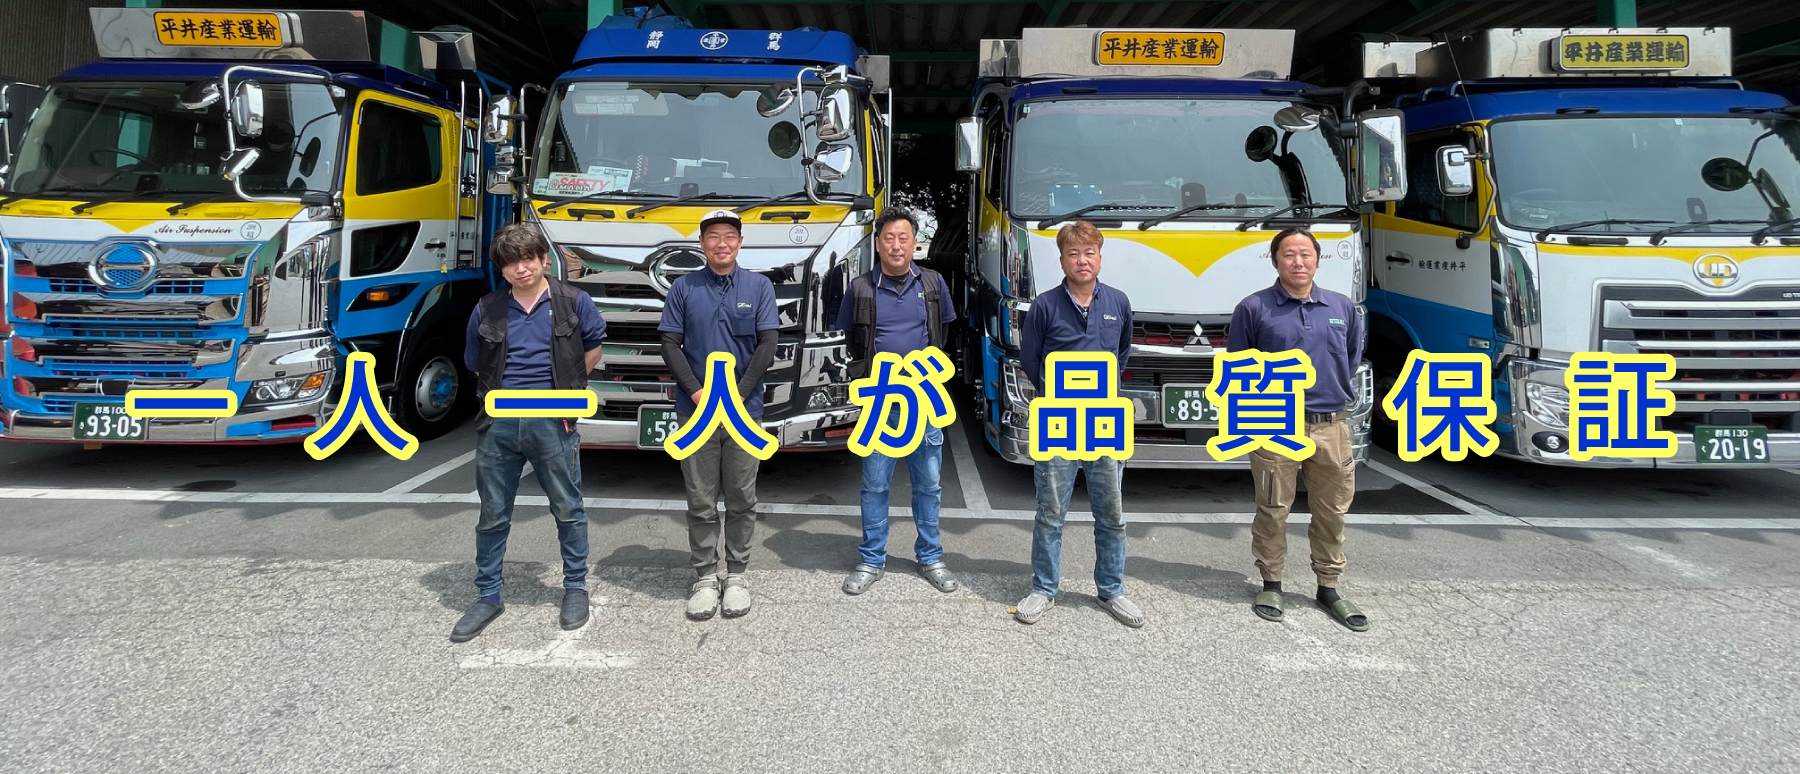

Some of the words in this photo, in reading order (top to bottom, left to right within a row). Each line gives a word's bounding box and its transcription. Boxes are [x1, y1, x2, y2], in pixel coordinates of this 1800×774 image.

[160, 18, 277, 40] 平井産業運輸
[1103, 37, 1220, 59] 平井産業運輸
[1564, 41, 1685, 63] 平井産業運輸
[560, 177, 611, 192] SAFETY
[154, 224, 174, 234] Air
[176, 224, 233, 237] Suspension
[1699, 262, 1737, 278] UD
[1178, 399, 1219, 421] 89-5
[86, 415, 143, 437] 93-05
[655, 421, 680, 443] 58
[1708, 438, 1766, 460] 20-19
